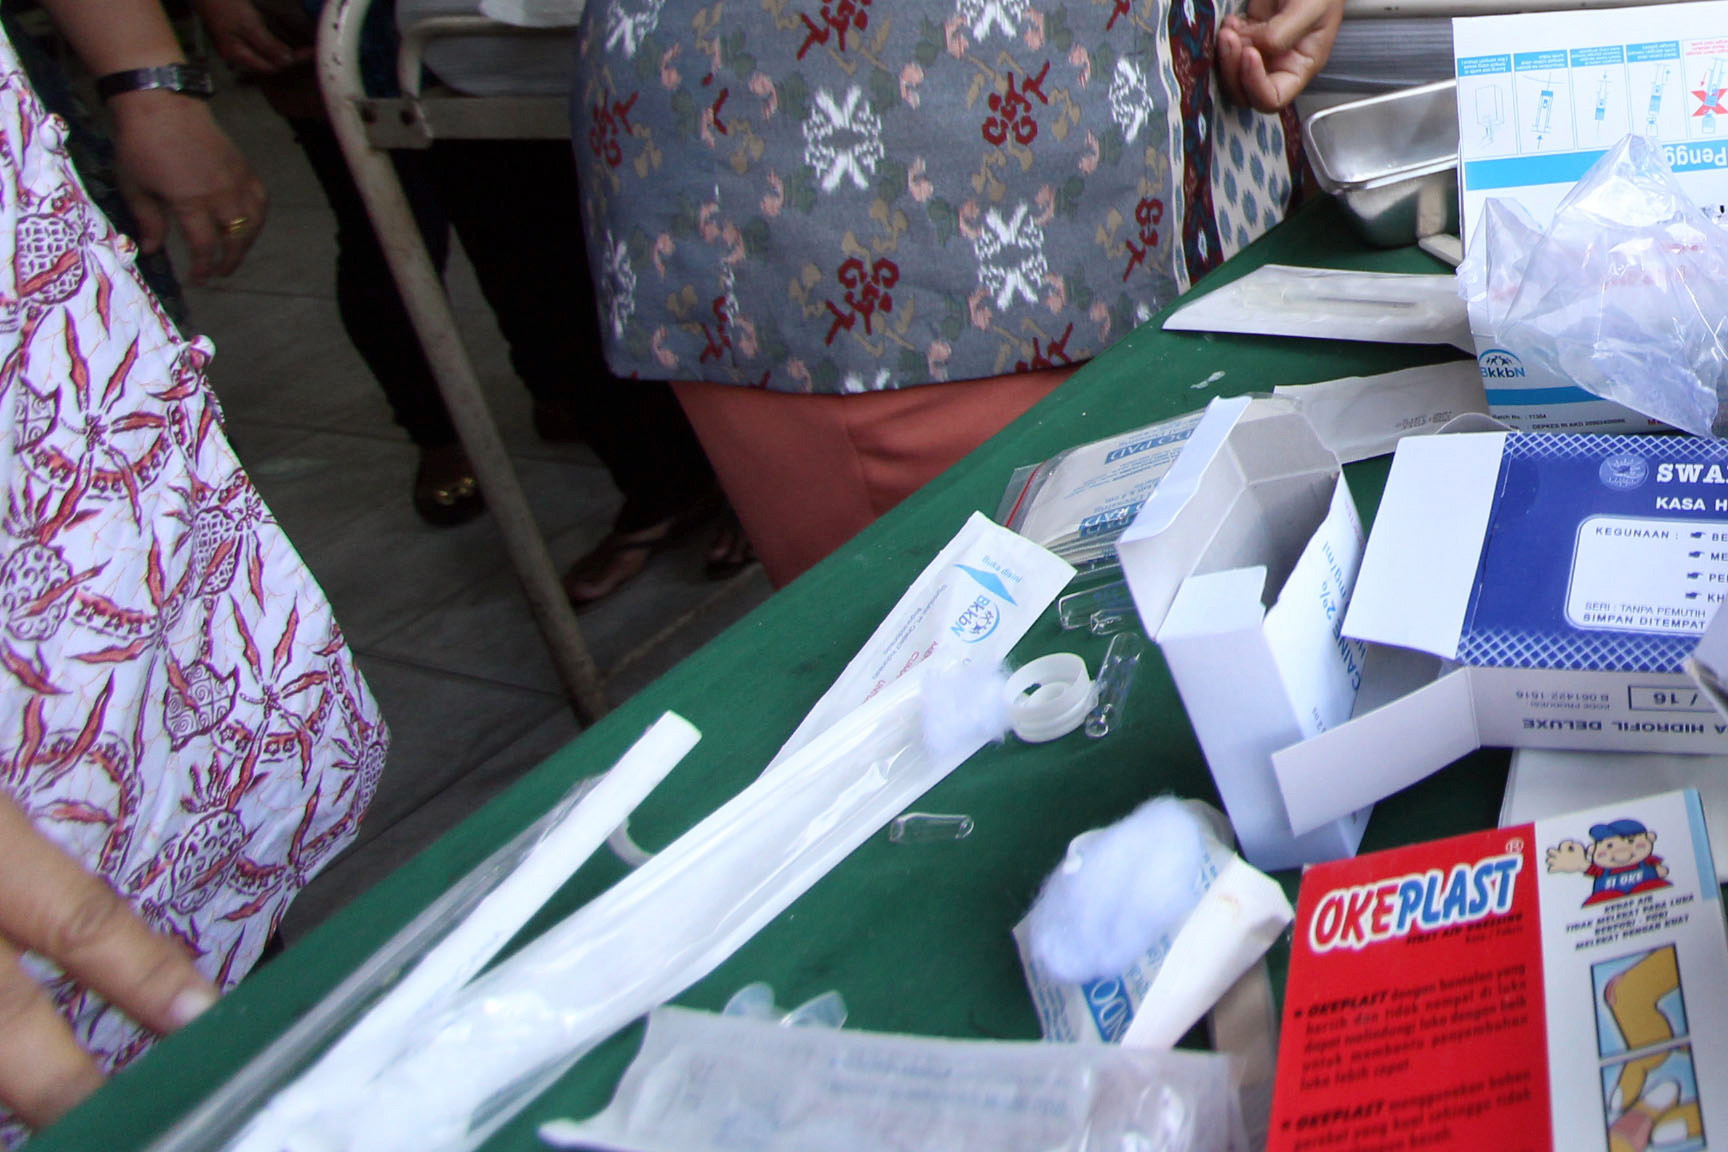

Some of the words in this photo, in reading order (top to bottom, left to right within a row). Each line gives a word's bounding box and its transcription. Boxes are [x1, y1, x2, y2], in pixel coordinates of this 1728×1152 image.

[1656, 497, 1706, 511] KASA
[1596, 527, 1670, 539] KEGUNAAN
[950, 594, 991, 637] BkkbN
[1585, 602, 1611, 612] SERI
[1621, 604, 1654, 615] TANPA
[1657, 607, 1706, 618] PEMUTIH
[1583, 614, 1633, 625] SIMPAN
[1640, 617, 1705, 629] DITEMPAT
[1653, 692, 1680, 705] 16
[1522, 718, 1602, 731] DELUXE
[1612, 721, 1704, 733] HIDROFIL
[1620, 870, 1643, 884] OKE
[1310, 854, 1522, 951] OKEPLAST
[1566, 921, 1593, 933] TIDAK
[1597, 909, 1639, 925] MELEKAT
[1575, 935, 1618, 950] MELEKAT
[1308, 990, 1387, 1017] OKEPLAST
